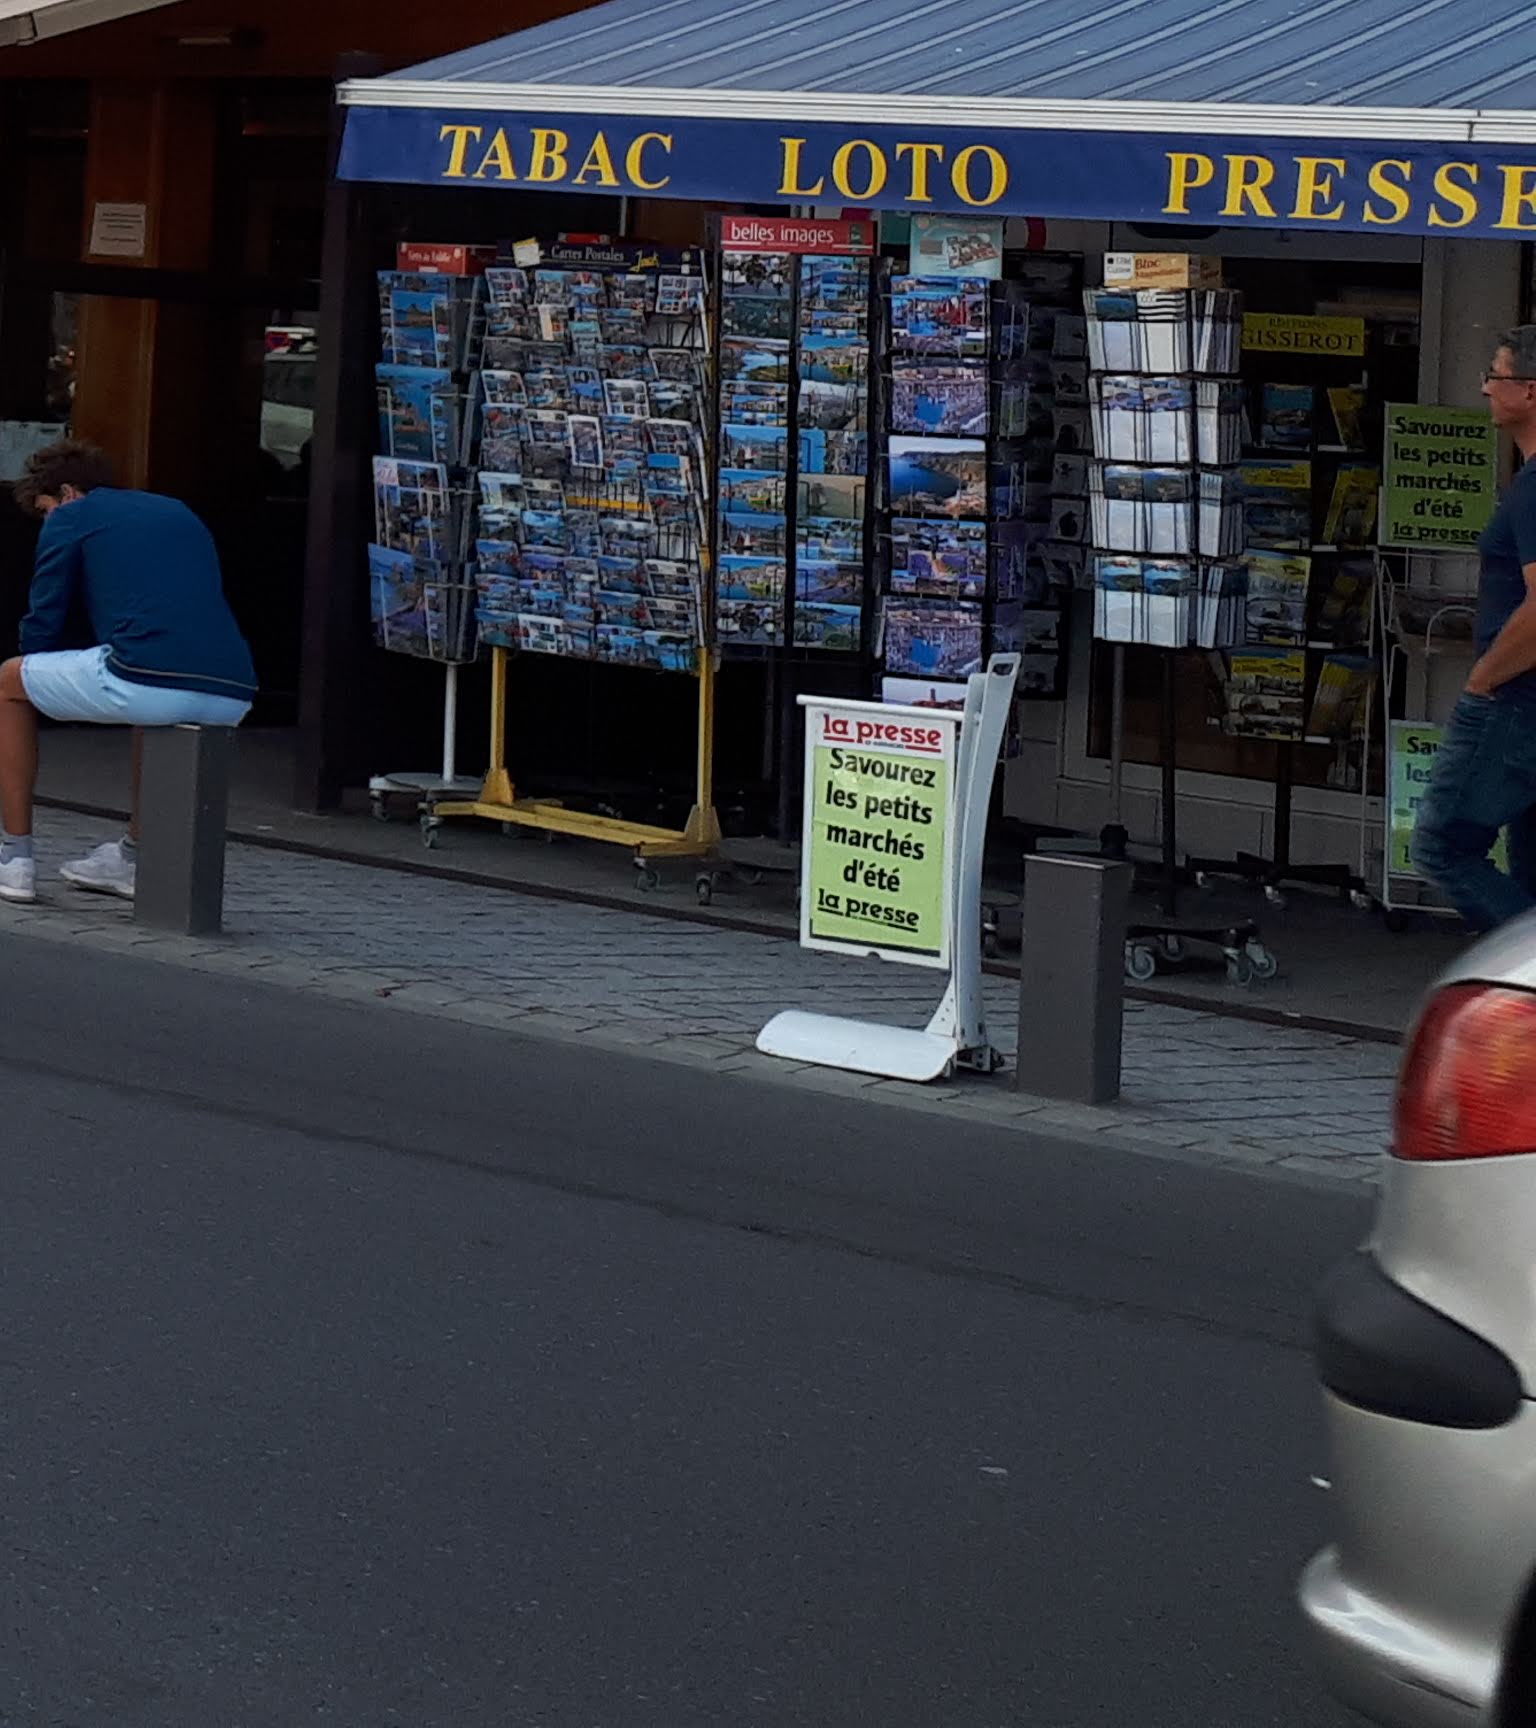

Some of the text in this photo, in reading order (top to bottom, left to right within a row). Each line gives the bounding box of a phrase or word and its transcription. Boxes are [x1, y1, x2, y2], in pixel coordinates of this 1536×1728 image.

[439, 124, 1536, 231] TABAC LOTO PRESSE
[730, 221, 834, 247] belles images
[551, 245, 625, 261] Cartes Postales
[1395, 416, 1487, 440] Savourez
[1393, 442, 1488, 467] les petits
[1396, 472, 1482, 494] marchés
[1413, 497, 1464, 519] d'été
[1393, 522, 1413, 536] la
[823, 713, 942, 746] la presse
[829, 747, 936, 788] Savourez
[825, 780, 933, 825] les petits
[826, 823, 926, 861] marchés
[843, 858, 901, 893] d'été
[817, 887, 920, 927] la presse
